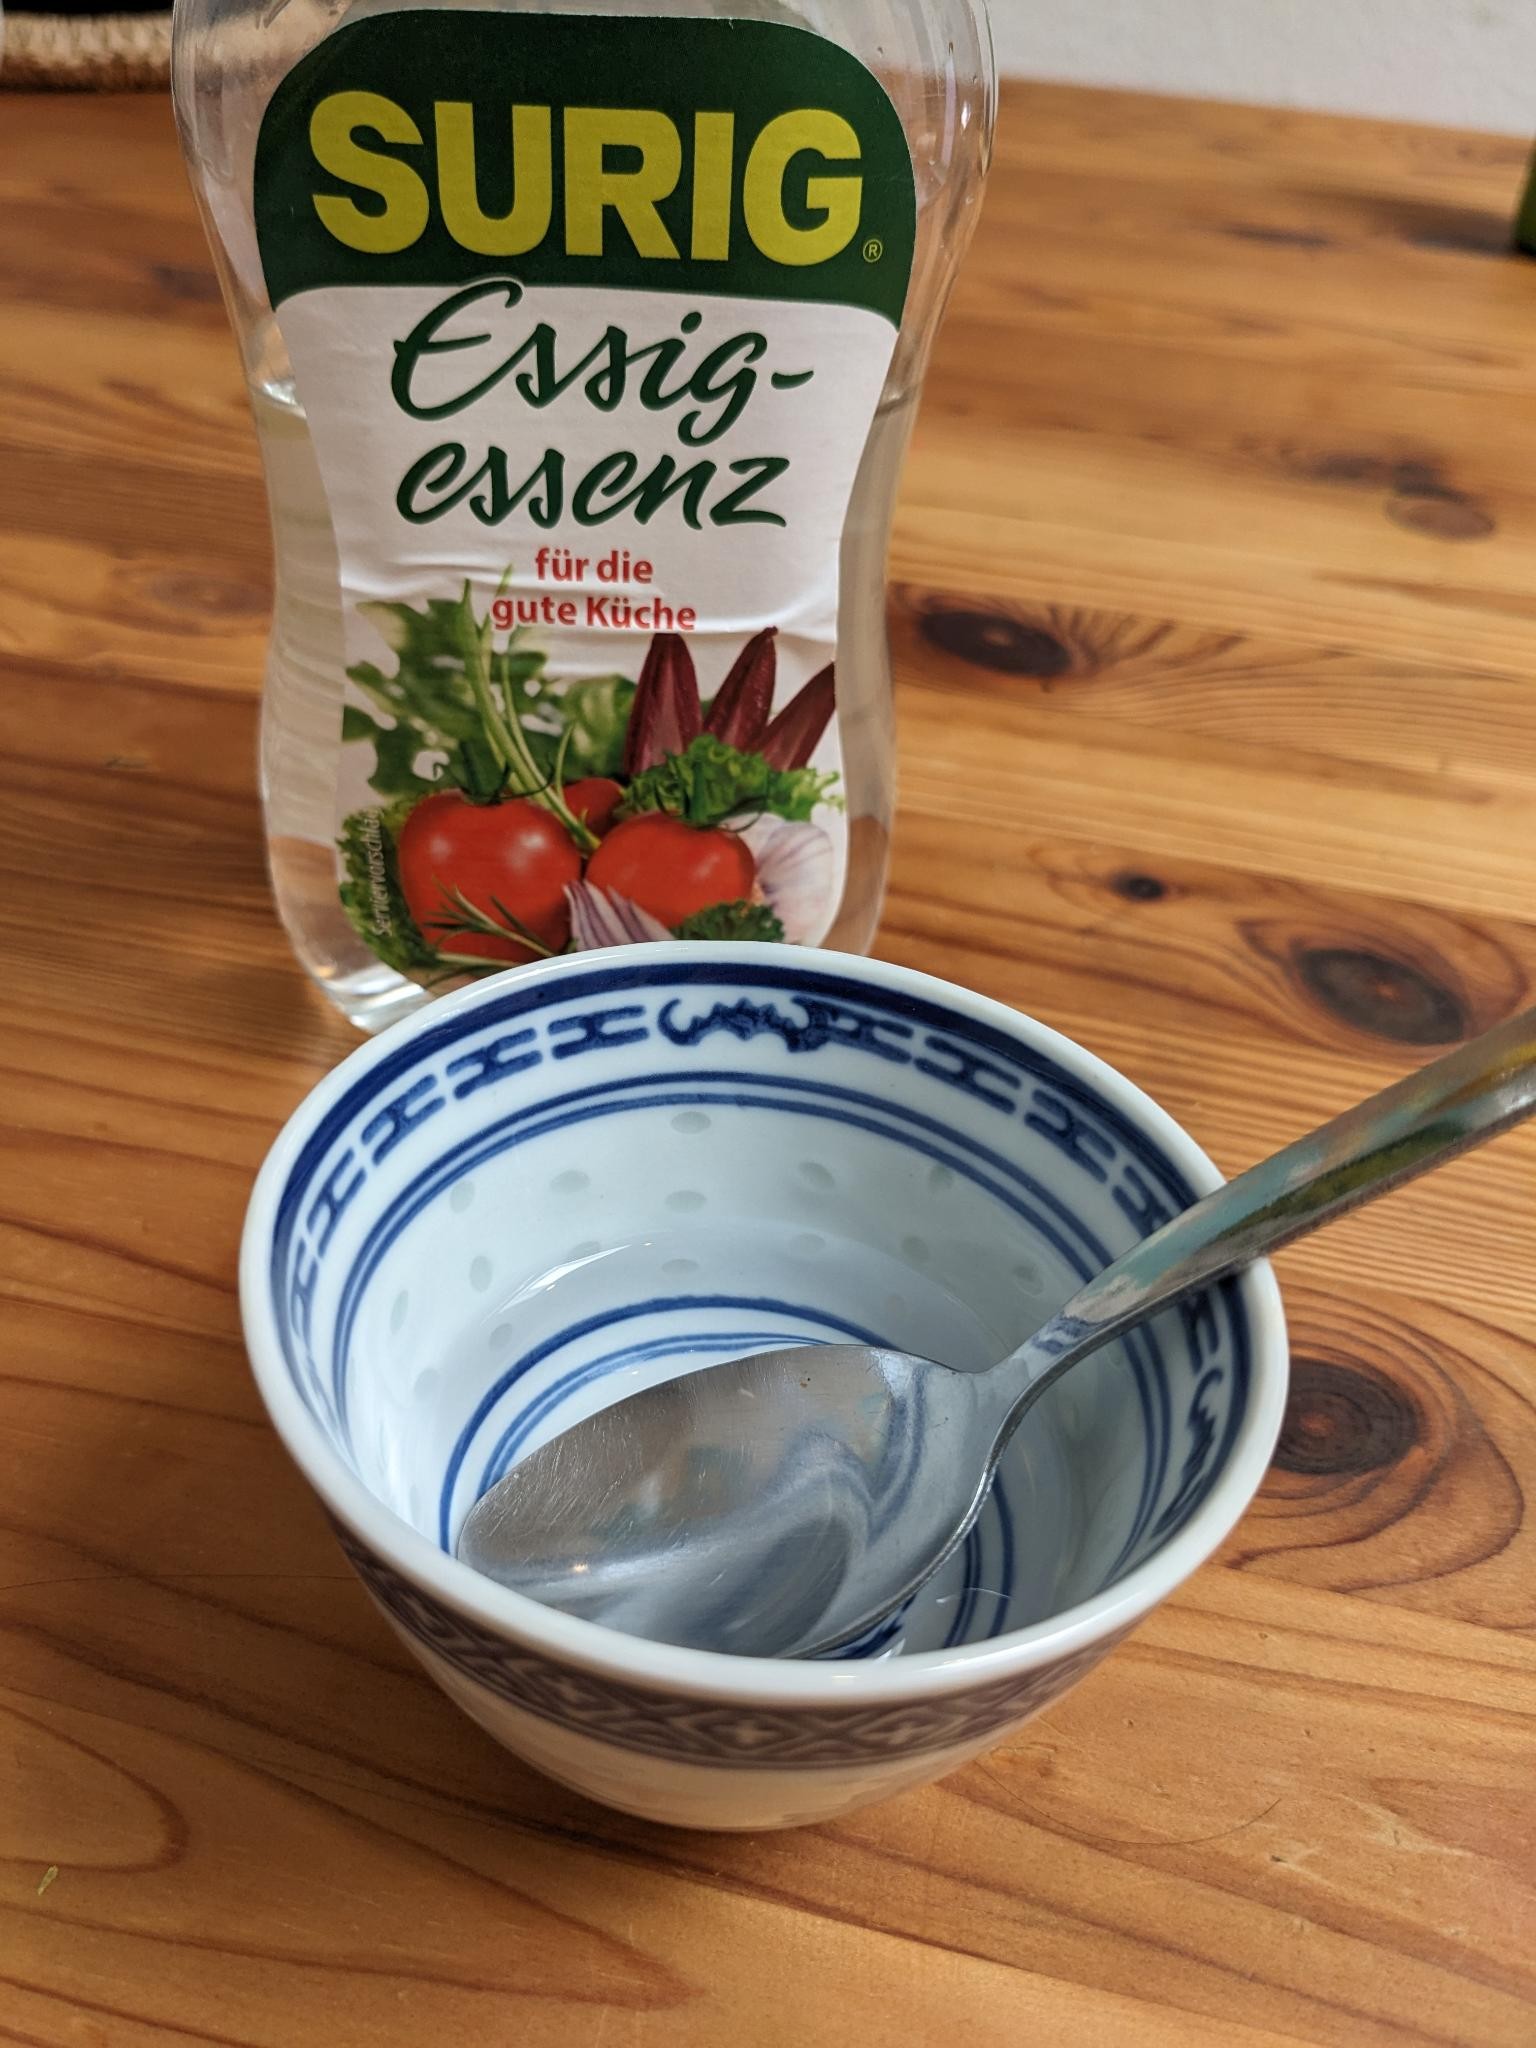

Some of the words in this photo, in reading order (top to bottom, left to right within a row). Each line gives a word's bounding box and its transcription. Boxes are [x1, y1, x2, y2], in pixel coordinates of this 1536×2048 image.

[309, 90, 864, 265] SURIG
[391, 278, 814, 447] Essig-
[395, 441, 792, 530] essenz
[491, 597, 577, 629] gute
[586, 597, 697, 630] Küche
[534, 547, 589, 582] für
[597, 550, 654, 583] die
[360, 807, 393, 937] Serviervorschlag
